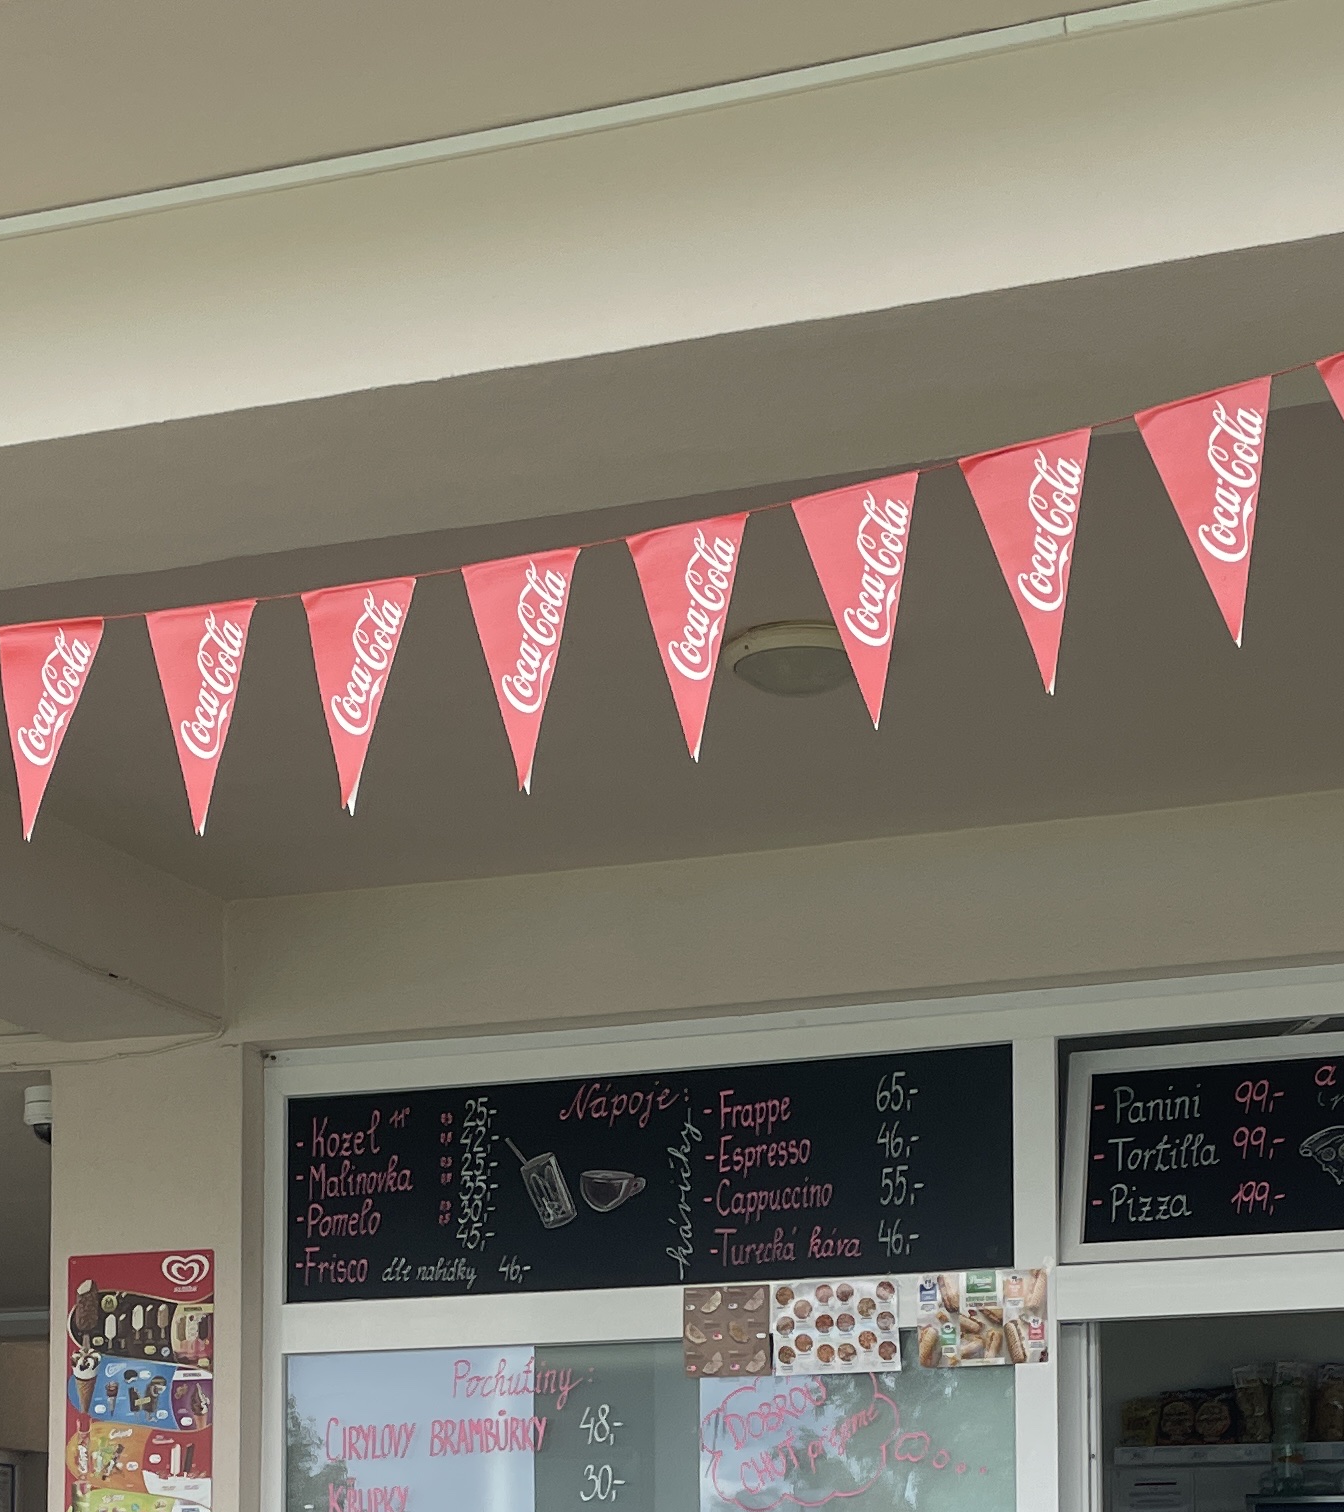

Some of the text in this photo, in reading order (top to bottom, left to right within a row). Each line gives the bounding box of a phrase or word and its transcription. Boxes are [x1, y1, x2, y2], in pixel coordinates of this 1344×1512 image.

[1197, 399, 1263, 563] Coca-Cola
[1017, 448, 1082, 612] Coca-Cola
[843, 489, 909, 647] Coca-Cola
[667, 527, 736, 681] Coca-Cola
[501, 559, 569, 714] Coca-Cola
[330, 588, 403, 736] Coca-Cola
[17, 627, 92, 767] Coca-Cola
[180, 610, 244, 760] Coca-Cola
[719, 1089, 792, 1134] Frappe
[876, 1071, 919, 1112] 65,-
[1114, 1084, 1202, 1124] Panini
[1235, 1080, 1285, 1114] 99,-
[312, 1109, 382, 1157] Kozel
[463, 1097, 497, 1128] 25,-
[459, 1126, 500, 1153] 42,-
[719, 1134, 811, 1178] Espresso
[876, 1120, 920, 1159] 46,-
[1108, 1133, 1221, 1173] Tortilla
[1233, 1126, 1286, 1160] 99,-
[309, 1154, 413, 1200] Malinovka
[461, 1152, 498, 1177] 25,-
[880, 1164, 925, 1206] 55,-
[458, 1175, 499, 1201] 35,-
[716, 1176, 834, 1224] Cappuccino
[1111, 1184, 1193, 1224] Pizza
[307, 1199, 381, 1237] Pomelo
[457, 1200, 496, 1223] 30,-
[456, 1222, 496, 1252] 45,-
[714, 1225, 862, 1267] Turecká káva
[878, 1217, 920, 1258] 46,-
[305, 1246, 368, 1286] Frisco
[498, 1255, 532, 1284] 46,-
[579, 1403, 624, 1446] 48,-
[580, 1464, 625, 1502] 30,-
